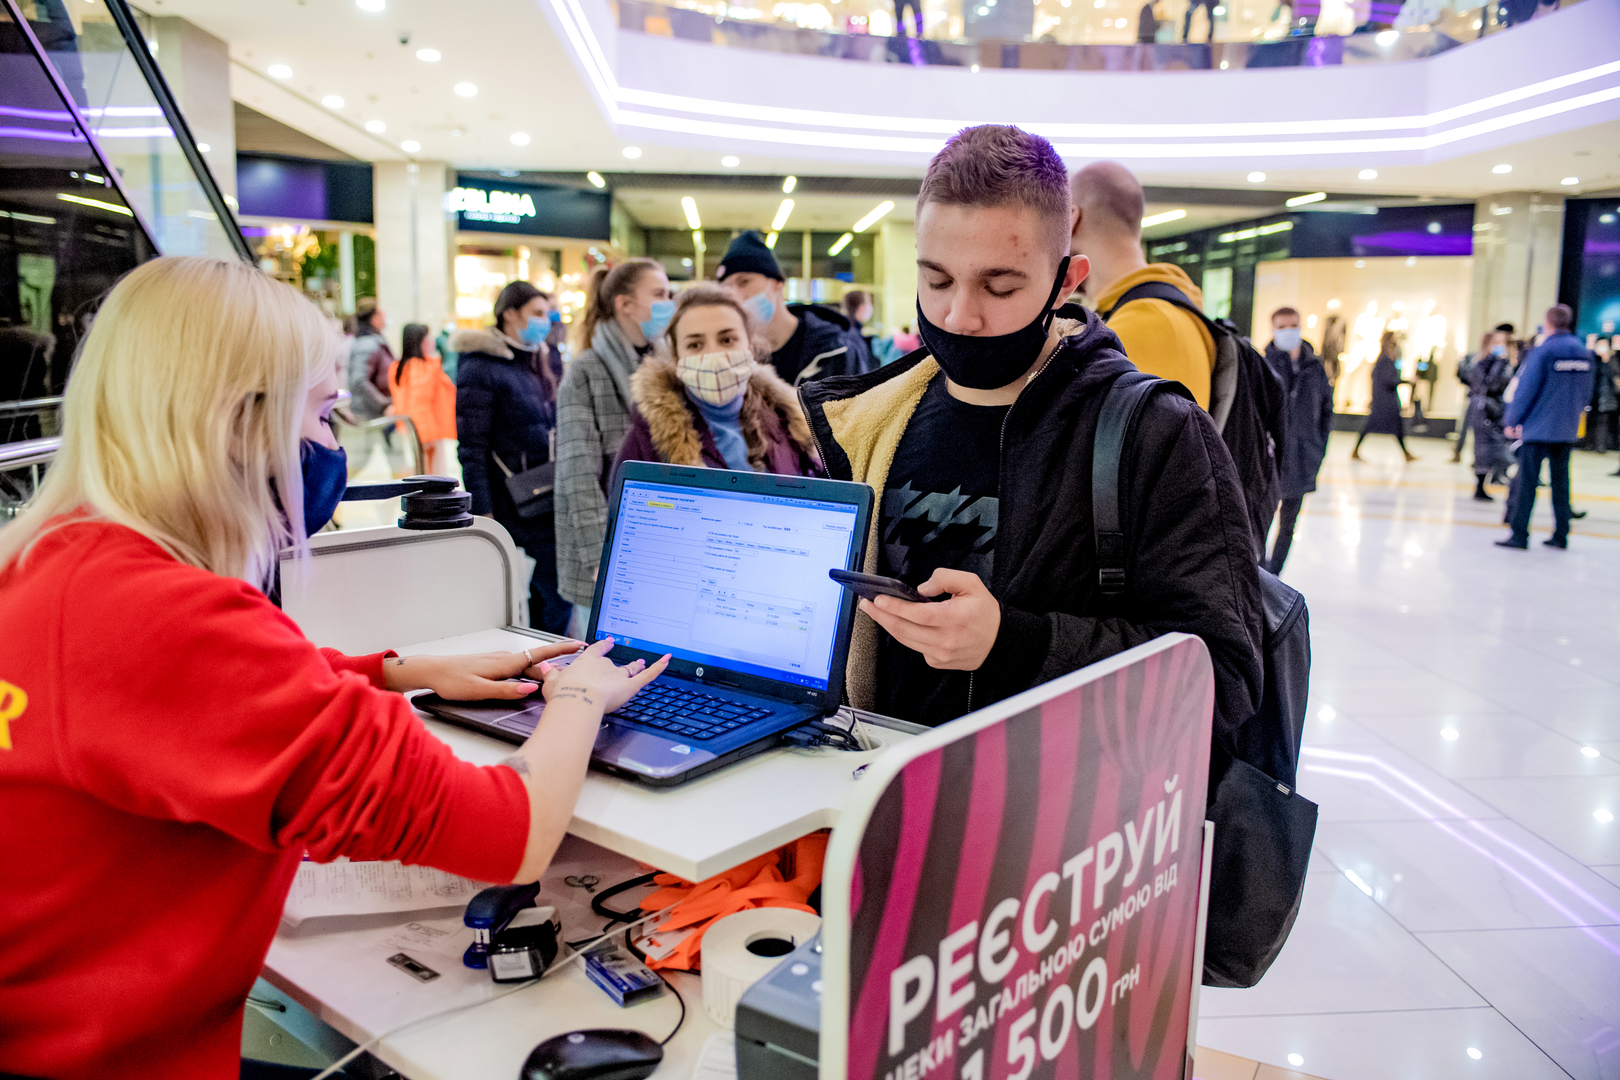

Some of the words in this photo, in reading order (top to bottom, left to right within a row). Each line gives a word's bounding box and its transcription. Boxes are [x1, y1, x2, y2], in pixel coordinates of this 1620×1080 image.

[888, 774, 1182, 1056] РЕЄСТРУЙ
[959, 933, 1086, 1047] ЗАГАЛЬНОЮ
[1089, 884, 1151, 947] СУМОЮ
[1154, 862, 1178, 898] ВІД
[1007, 957, 1108, 1080] 500
[1111, 964, 1141, 1007] ГРН
